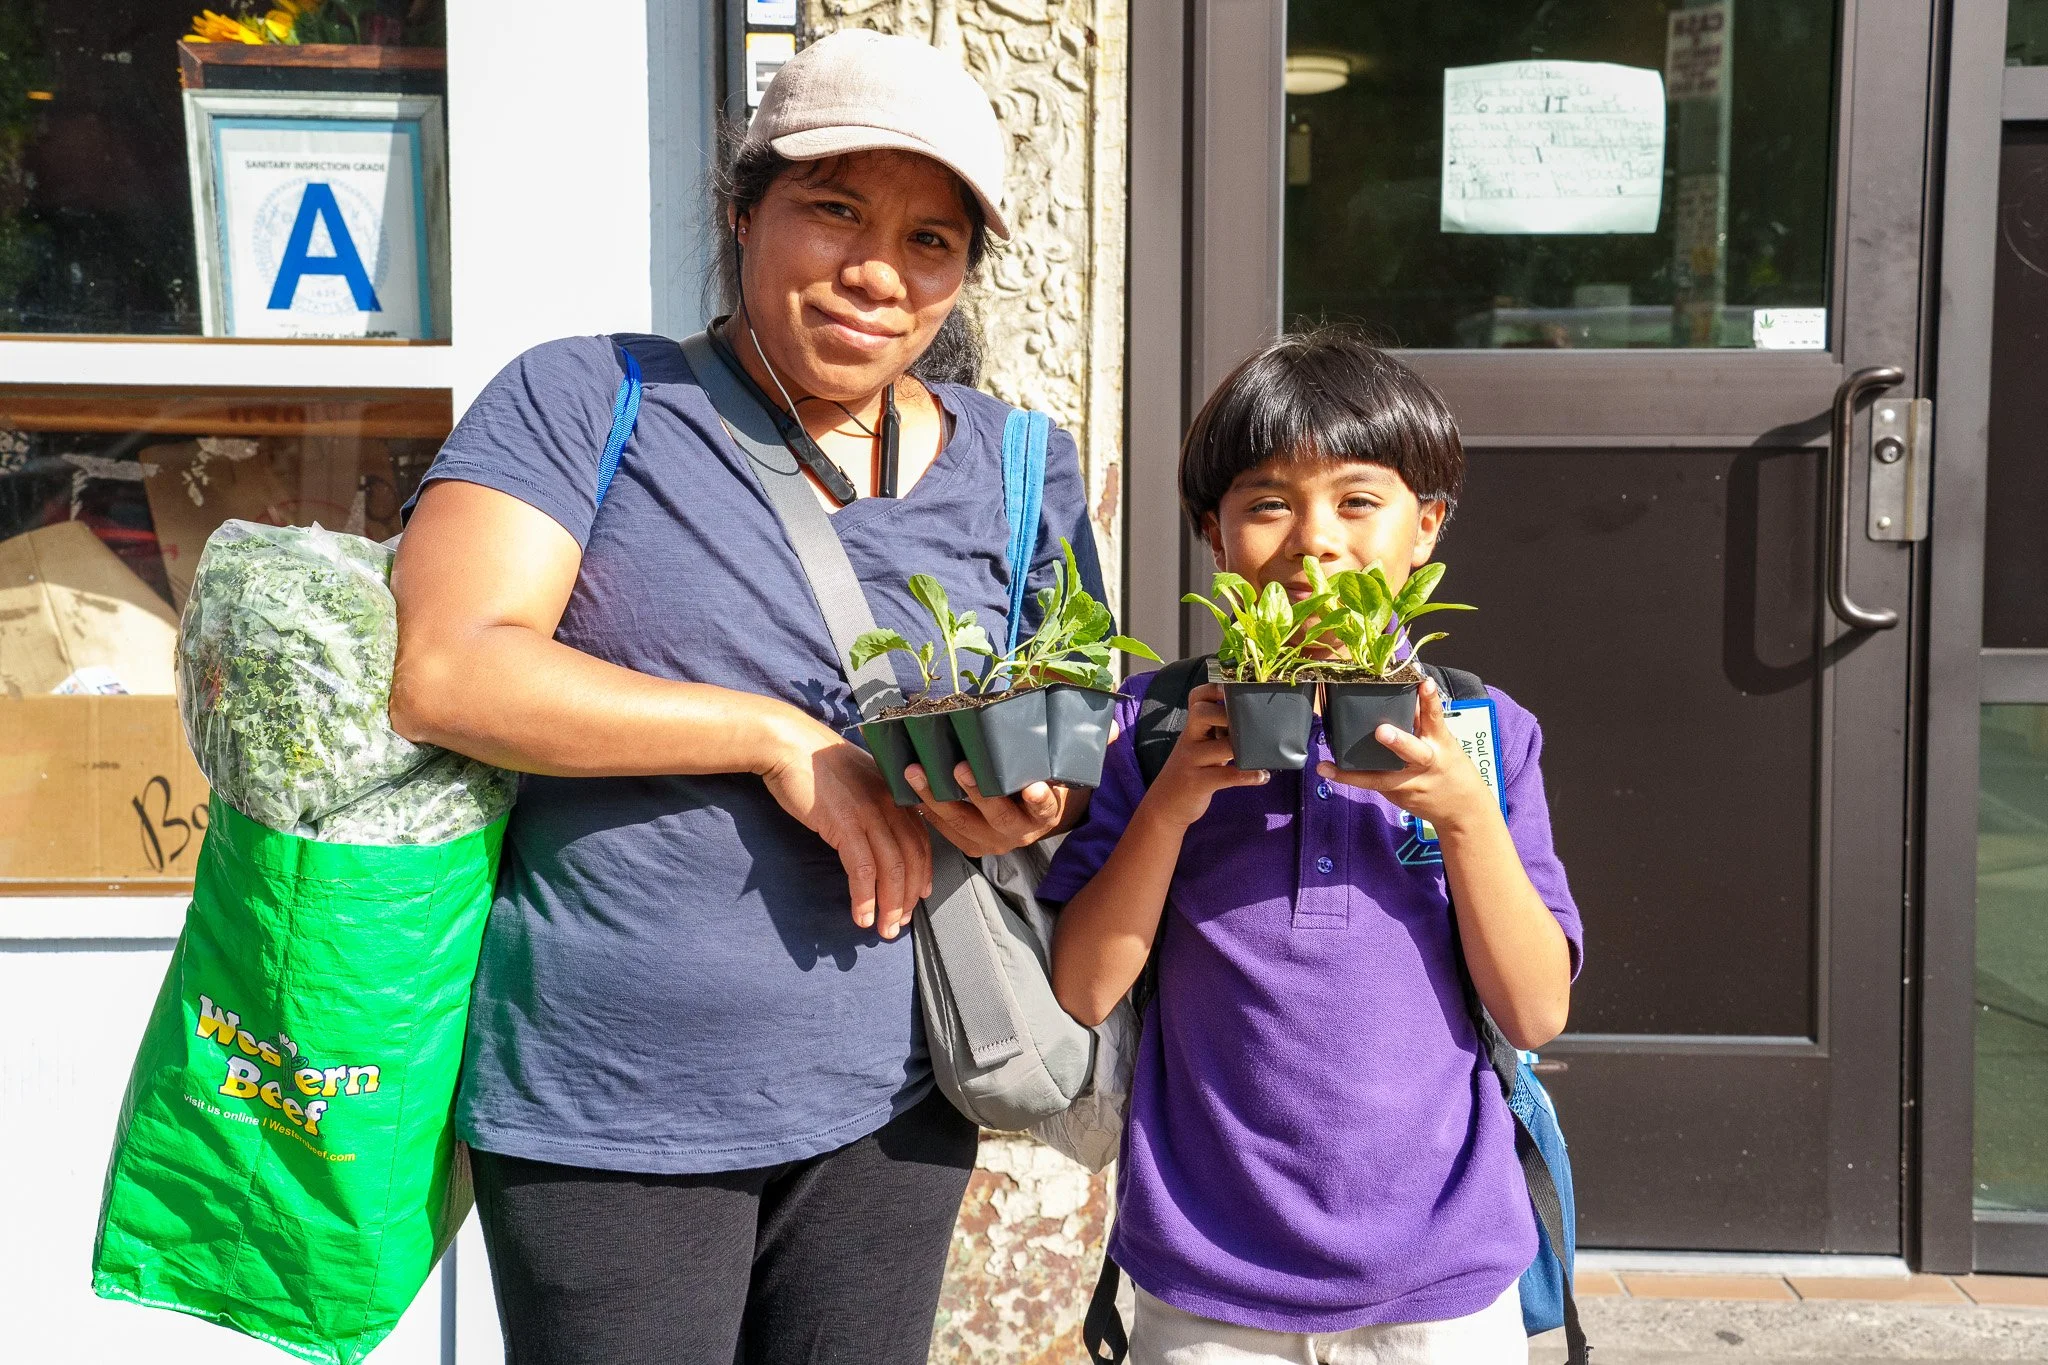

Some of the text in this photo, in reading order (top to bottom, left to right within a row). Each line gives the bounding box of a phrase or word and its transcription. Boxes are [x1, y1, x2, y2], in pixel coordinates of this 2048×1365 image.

[245, 160, 385, 172] SANITARY INSPECTION GRADE
[266, 183, 382, 311] A
[1461, 740, 1472, 759] Alt
[1475, 731, 1489, 757] Saul
[218, 1055, 328, 1136] Beef
[183, 1093, 205, 1110] visit
[207, 1104, 221, 1116] us
[223, 1111, 260, 1126] online
[269, 1118, 357, 1162] Westernbeef.com
